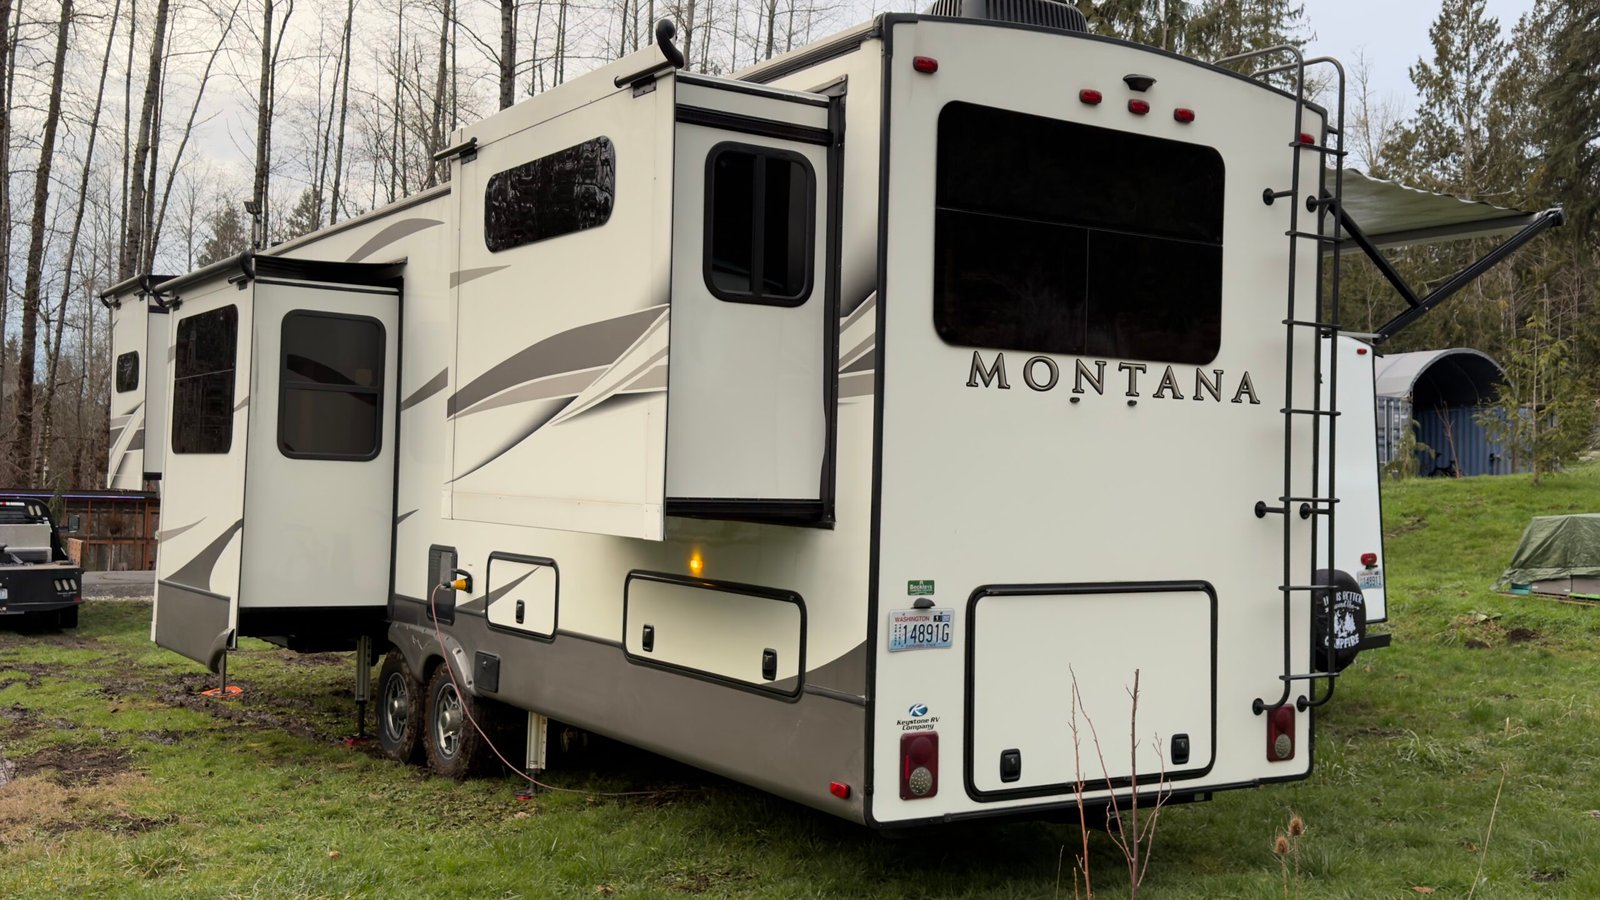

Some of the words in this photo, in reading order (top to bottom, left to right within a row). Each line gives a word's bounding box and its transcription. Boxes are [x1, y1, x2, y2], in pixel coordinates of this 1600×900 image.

[965, 350, 1261, 405] MONTANA
[1342, 591, 1363, 604] BETTER
[895, 615, 931, 623] WASHINGTON
[903, 623, 950, 645] 14891G
[1324, 633, 1360, 649] CMPFIRE
[896, 718, 930, 726] Keystone
[902, 723, 934, 731] Company
